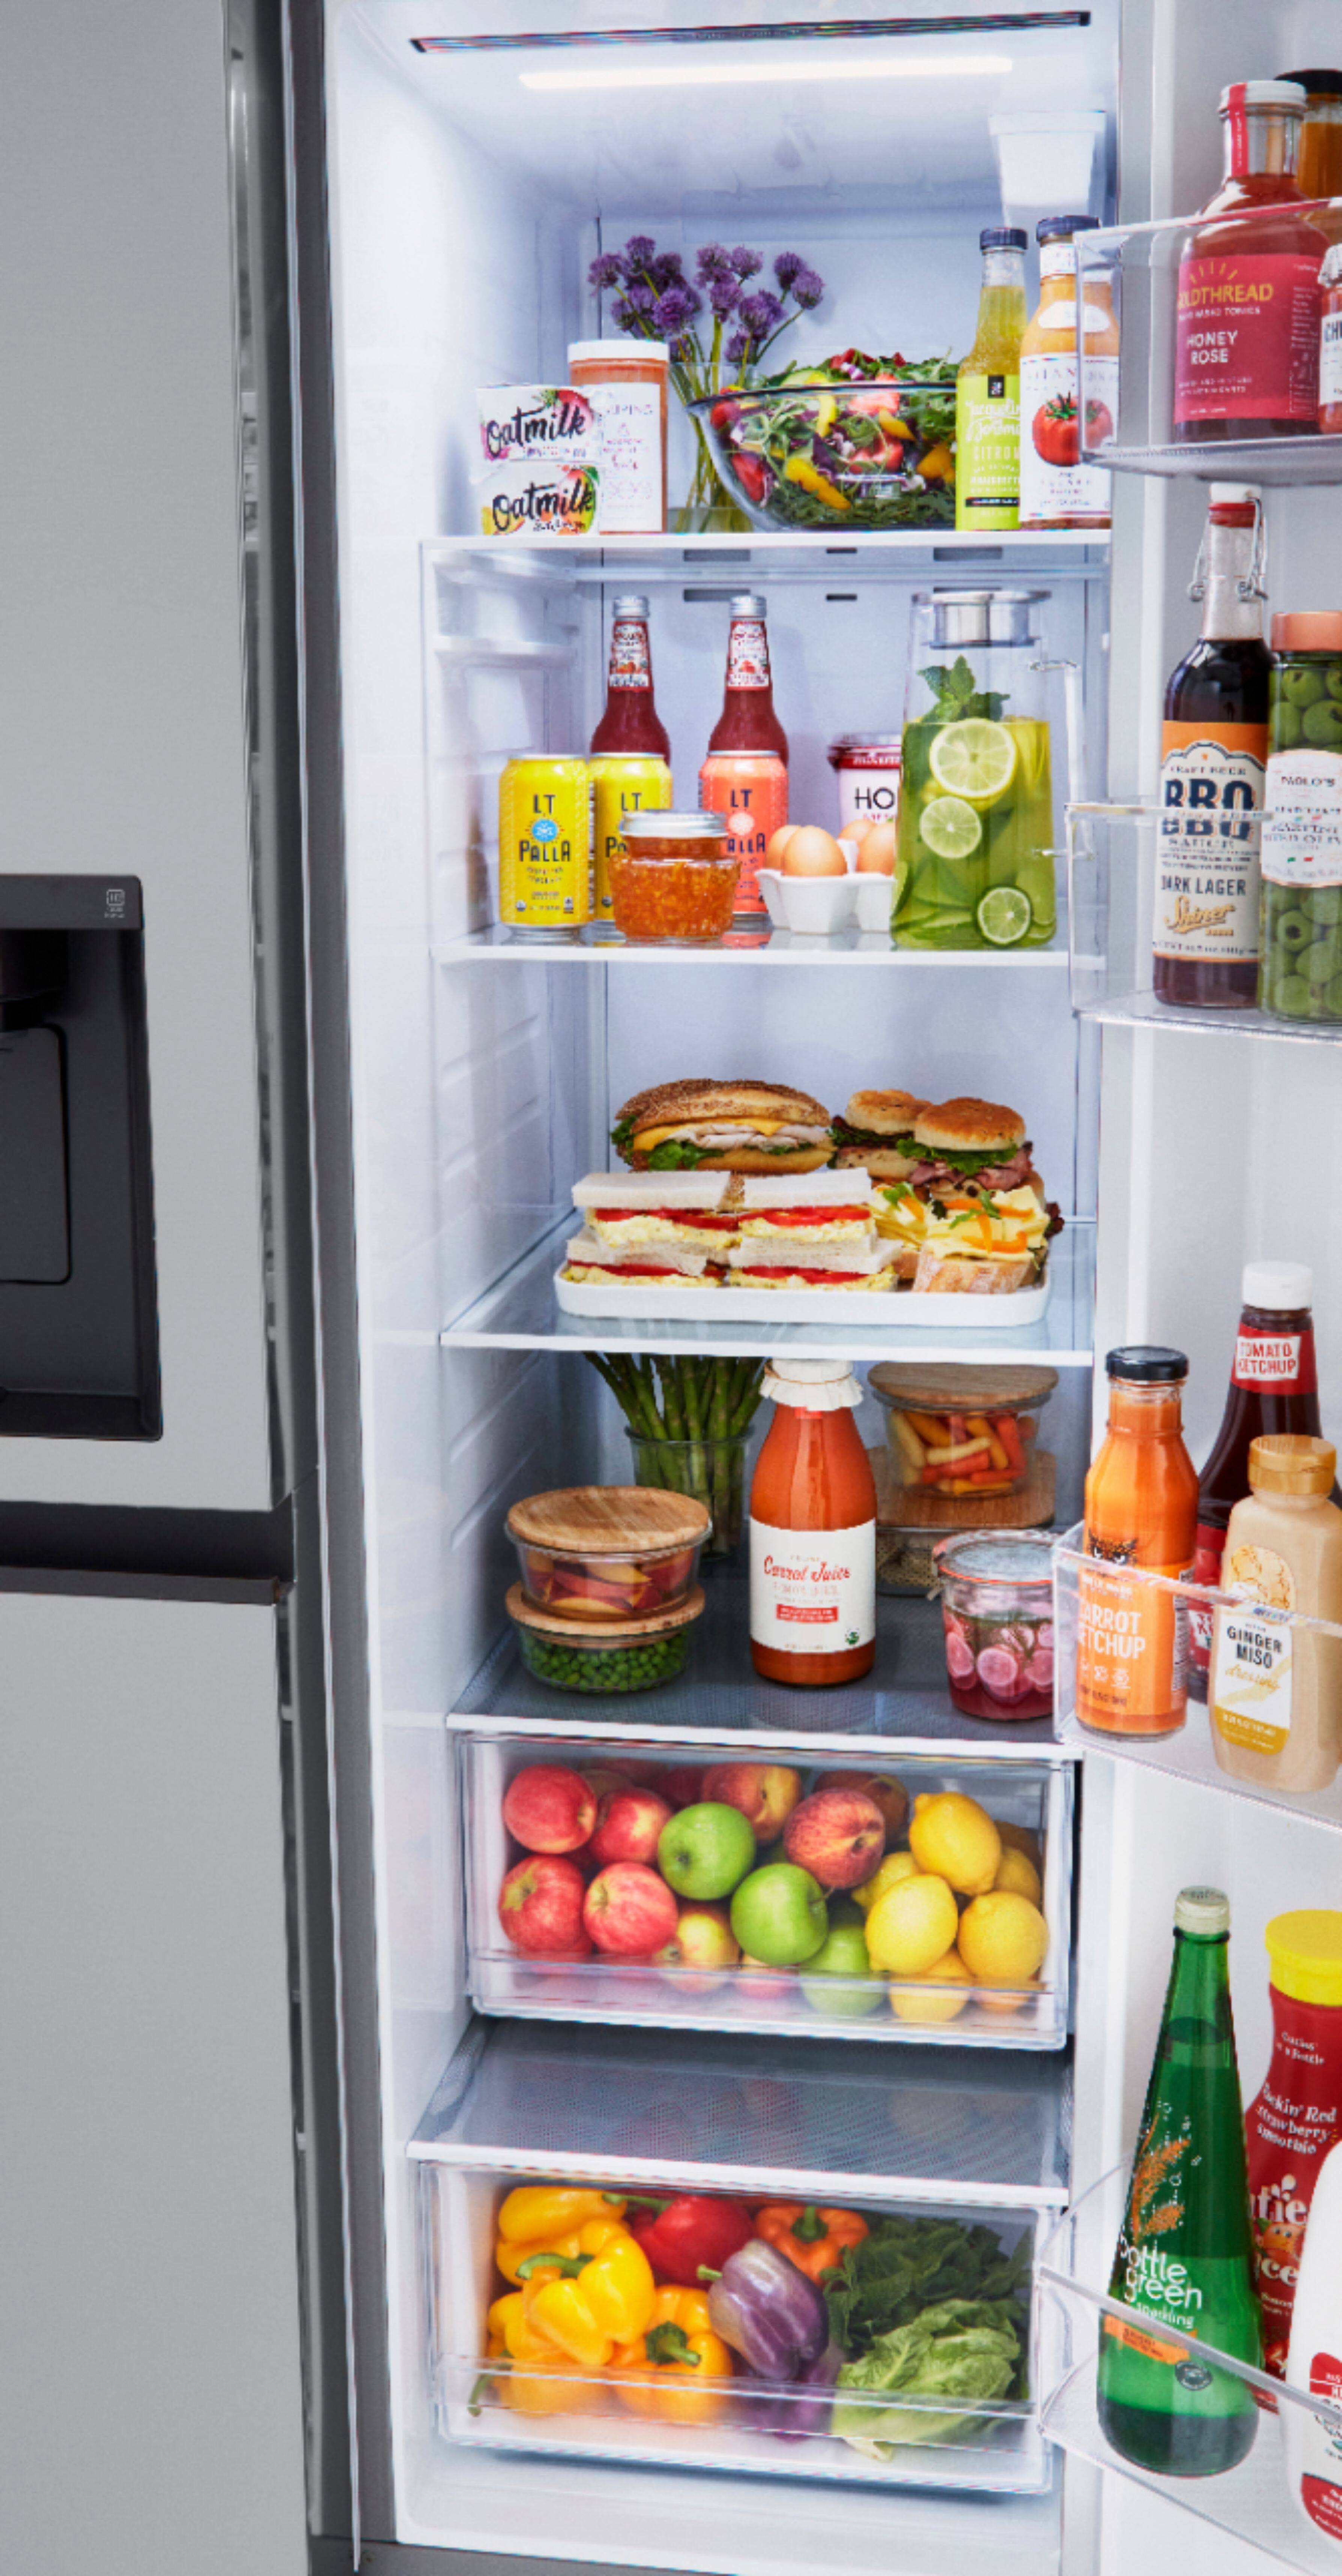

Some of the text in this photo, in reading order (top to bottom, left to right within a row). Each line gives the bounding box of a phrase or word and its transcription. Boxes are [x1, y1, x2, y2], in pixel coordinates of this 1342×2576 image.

[1188, 329, 1238, 349] HONEY
[1190, 348, 1229, 365] ROSE
[487, 401, 585, 458] Oatmilk
[492, 477, 593, 531] Oatmilk
[533, 793, 556, 814] LT
[731, 789, 752, 807] LT
[854, 787, 895, 809] HO
[1162, 778, 1255, 842] BBQ
[519, 839, 570, 862] PALLA
[727, 832, 765, 854] ALLA
[1195, 876, 1246, 896] LAGER
[1227, 1625, 1282, 1655] GINGER
[1237, 1643, 1273, 1669] MISO
[1306, 2106, 1337, 2123] Red
[1120, 2232, 1188, 2285] bottle
[1124, 2267, 1202, 2309] green
